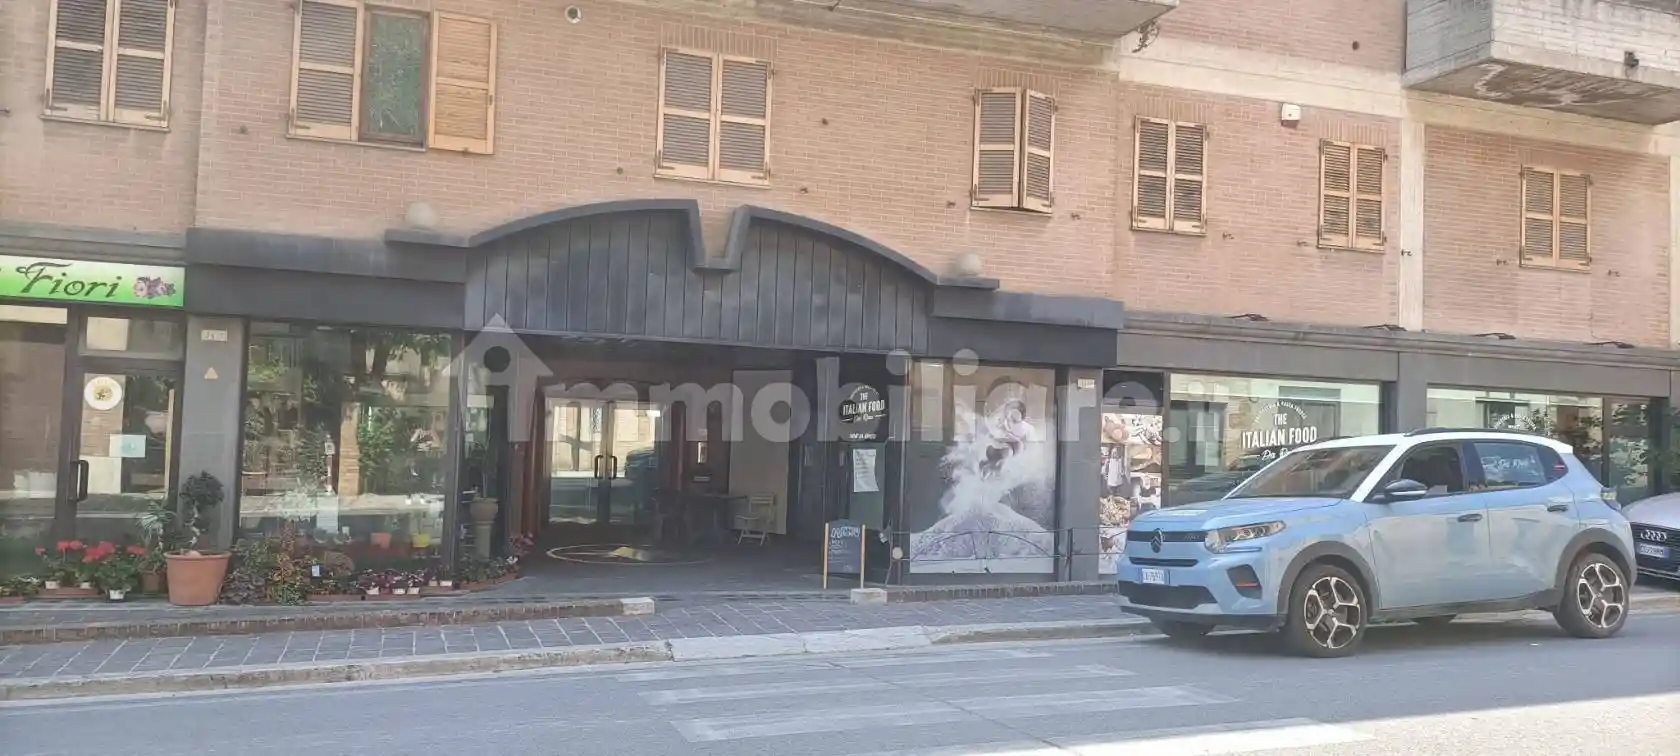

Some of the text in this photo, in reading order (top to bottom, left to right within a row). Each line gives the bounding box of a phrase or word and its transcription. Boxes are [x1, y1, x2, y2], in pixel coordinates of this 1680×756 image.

[16, 261, 123, 298] Fiori
[842, 400, 885, 416] ITALIAN FOOD
[1274, 413, 1288, 425] THE
[1242, 426, 1318, 449] ITALIAN FOOD
